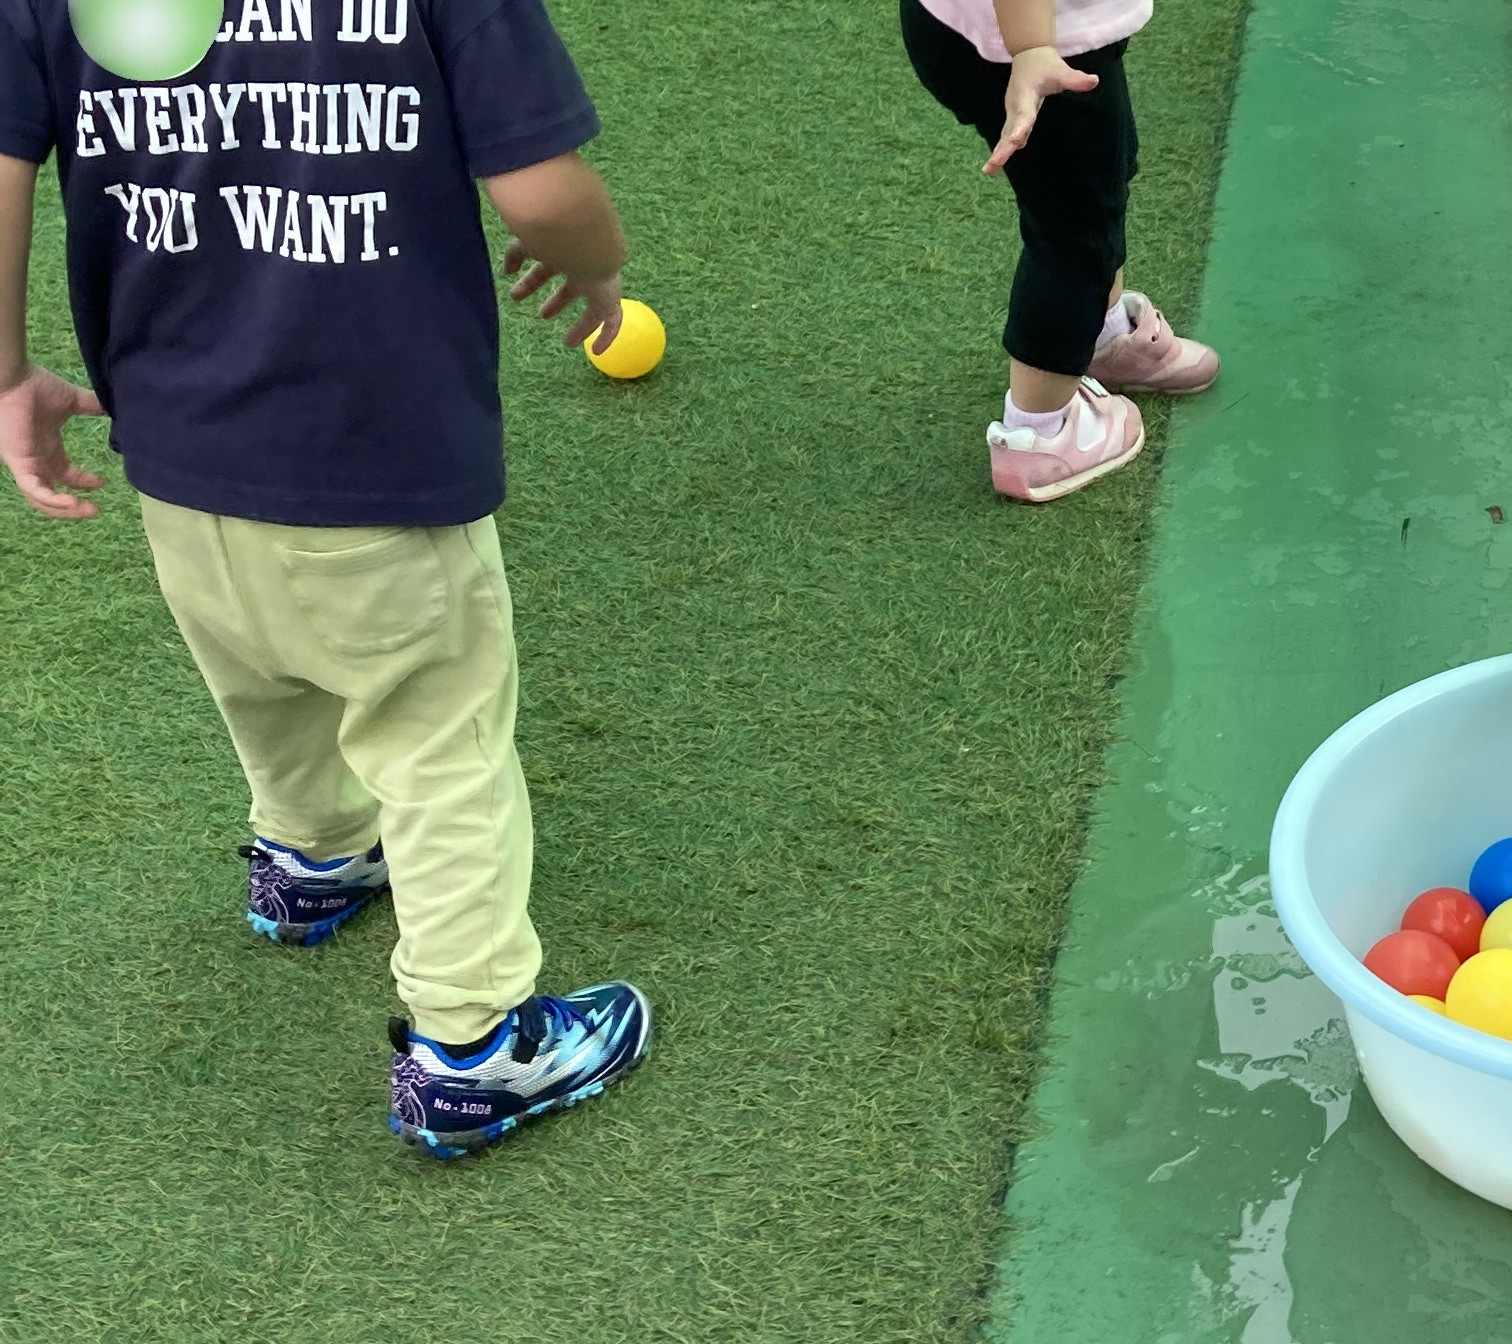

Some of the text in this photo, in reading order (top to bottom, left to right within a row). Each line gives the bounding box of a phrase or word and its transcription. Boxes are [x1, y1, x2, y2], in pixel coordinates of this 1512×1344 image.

[76, 81, 422, 157] EVERYTHING
[103, 182, 400, 264] YOU WANT.
